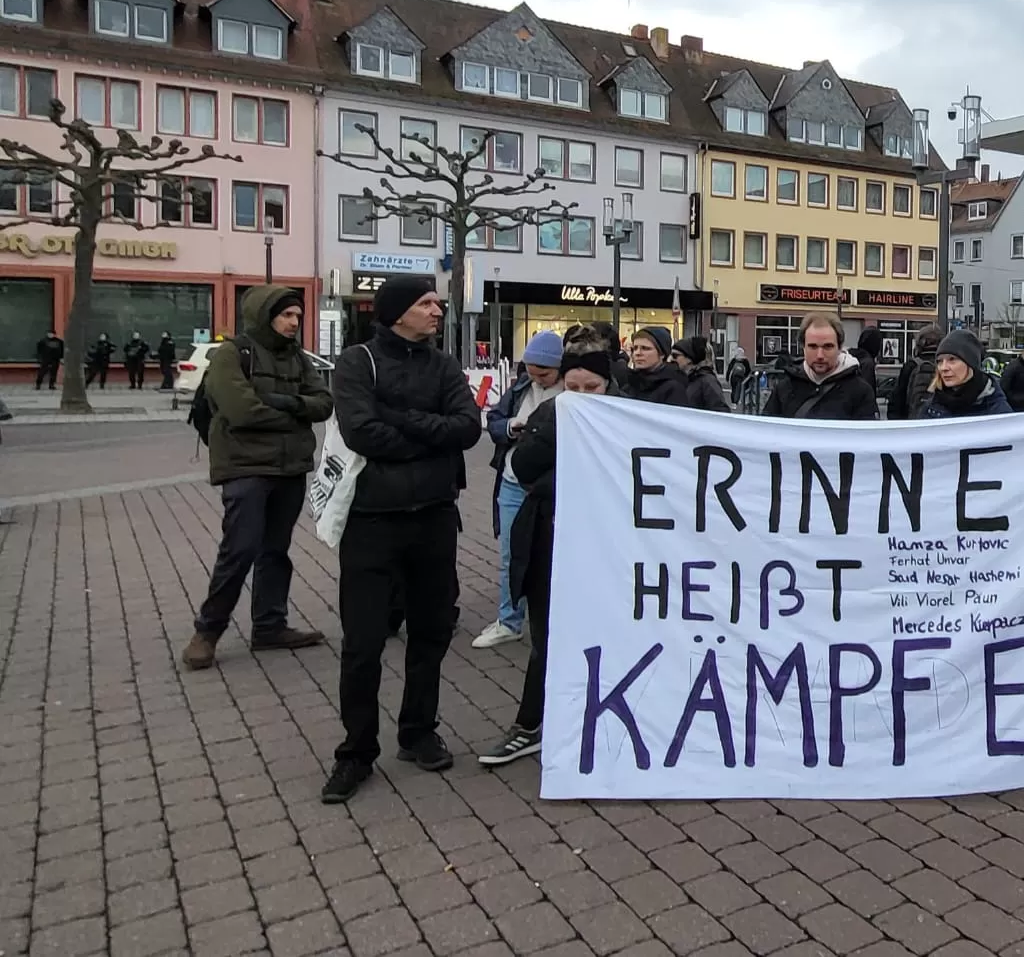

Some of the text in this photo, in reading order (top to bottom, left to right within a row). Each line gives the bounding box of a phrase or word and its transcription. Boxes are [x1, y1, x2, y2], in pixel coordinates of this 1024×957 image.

[360, 255, 413, 265] Zahnärzte
[561, 285, 585, 301] Ulla
[868, 293, 914, 305] HAIRLINE
[888, 535, 1009, 552] Hamza Kurtovic
[889, 552, 930, 567] Ferhat
[888, 569, 919, 584] Said
[969, 566, 1021, 584] Hashemi
[633, 559, 862, 630] HEIßT
[890, 593, 908, 608] Vili
[916, 590, 955, 608] Viorel
[892, 615, 962, 634] Mercedes
